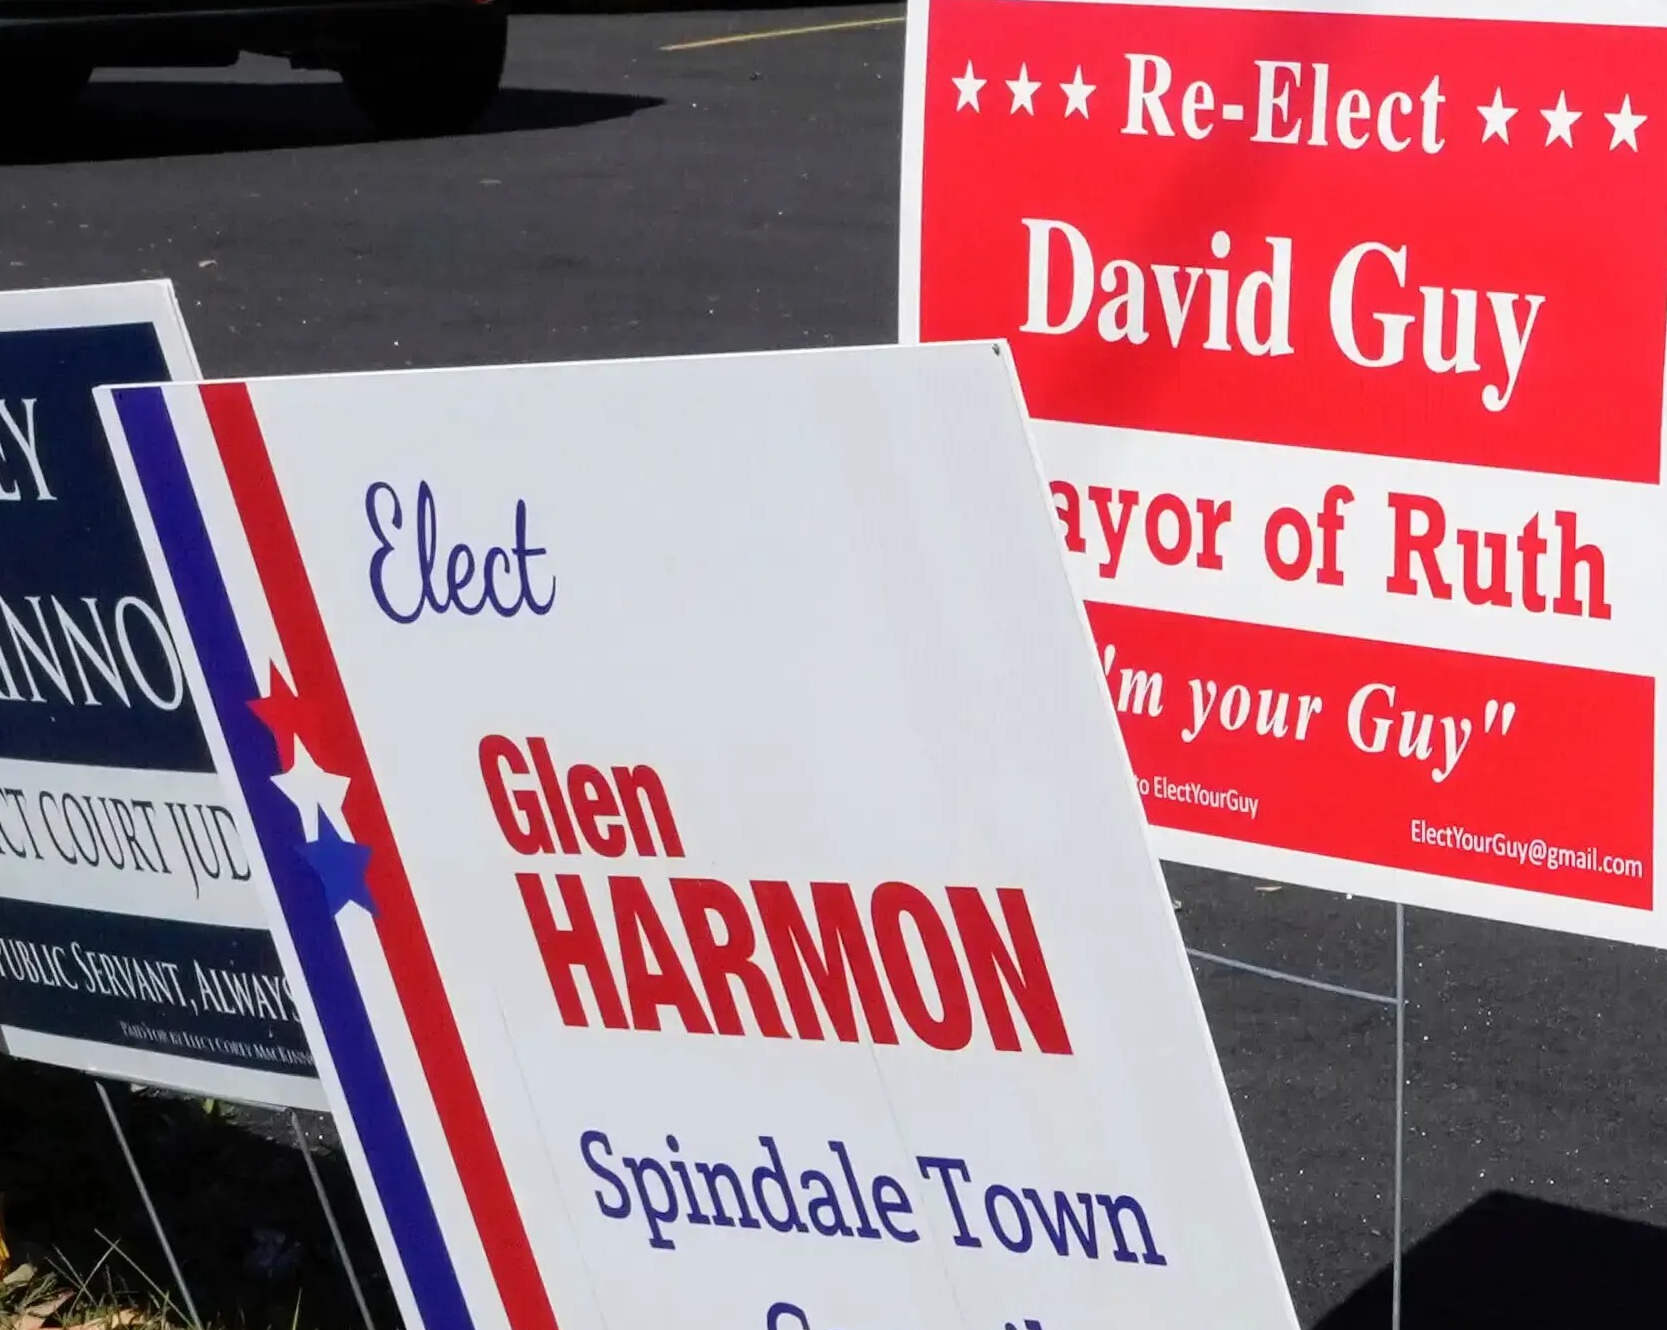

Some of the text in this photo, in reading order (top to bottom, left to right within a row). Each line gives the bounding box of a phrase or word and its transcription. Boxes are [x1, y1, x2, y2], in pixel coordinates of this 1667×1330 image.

[1119, 52, 1448, 156] Re-Elect
[1019, 217, 1546, 413] David Guy
[363, 479, 556, 626] Elect
[1047, 477, 1612, 620] ayor of Ruth
[1180, 678, 1323, 743] your
[1344, 680, 1517, 785] Guy"
[39, 791, 173, 873] COURT
[164, 802, 252, 900] JUD
[477, 732, 686, 861] Glen
[1153, 775, 1259, 820] ElectYourGuy
[1409, 817, 1645, 881] ElectYourGuy@gmail.com
[516, 872, 1075, 1058] HARMON
[577, 1129, 1168, 1269] Spindale Town
